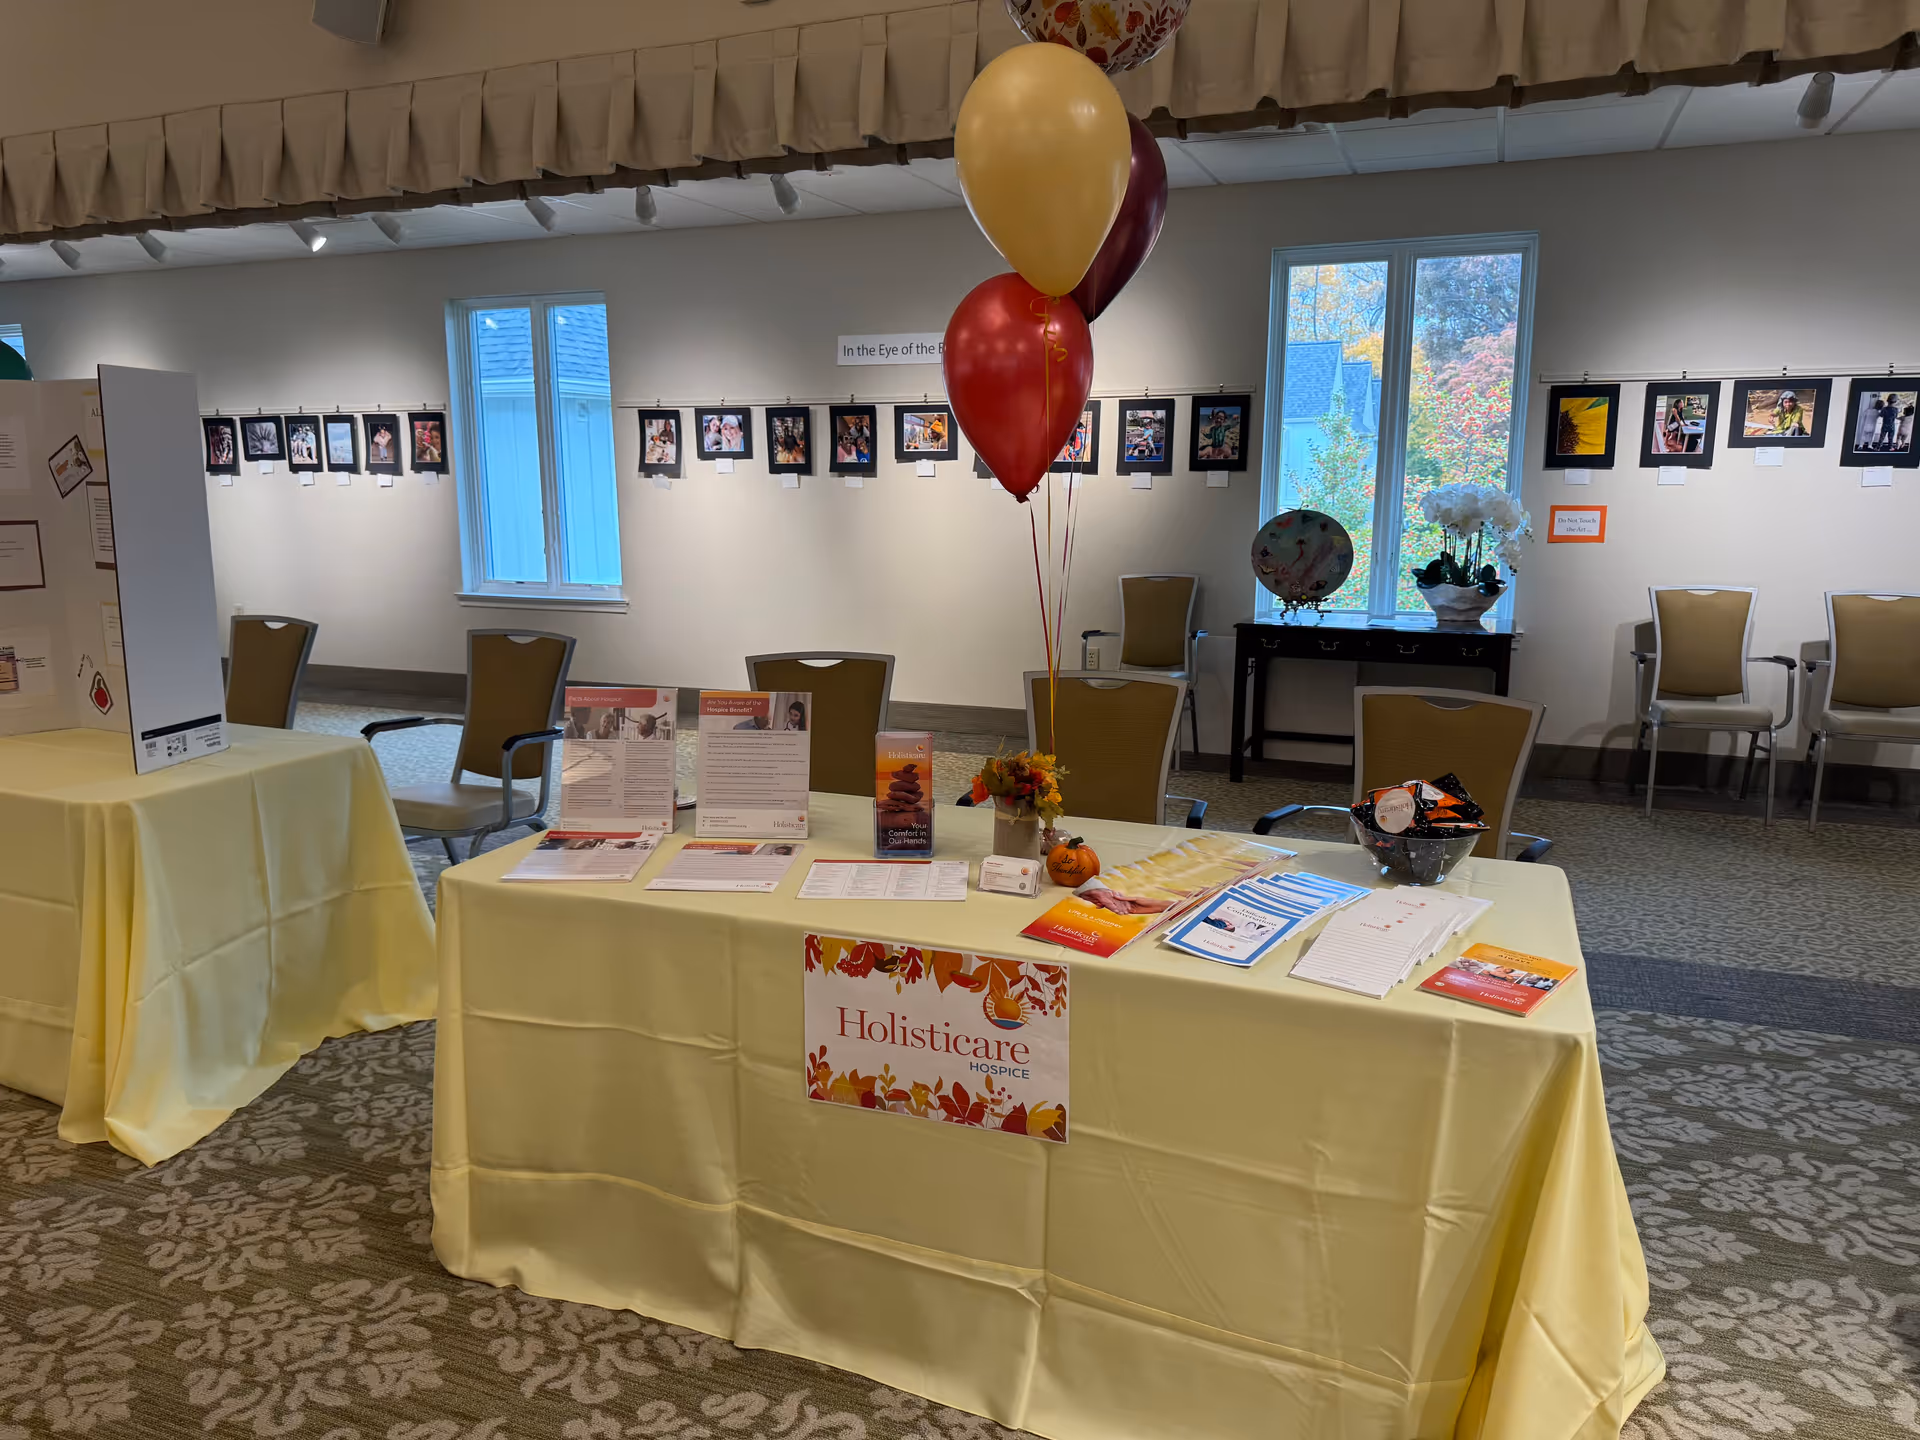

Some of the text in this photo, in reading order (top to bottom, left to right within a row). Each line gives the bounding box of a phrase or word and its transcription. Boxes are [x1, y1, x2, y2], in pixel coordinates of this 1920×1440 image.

[843, 344, 854, 357] In
[857, 344, 876, 356] the
[879, 344, 898, 359] Eye
[902, 343, 914, 355] of
[916, 342, 935, 355] the
[1061, 854, 1075, 864] So
[1051, 862, 1086, 877] Thankful
[1095, 917, 1123, 928] Journey
[1226, 906, 1277, 927] Conversations
[1053, 924, 1098, 942] Holisticare
[836, 1005, 1030, 1065] Holisticare
[969, 1061, 1030, 1080] HOSPICE
